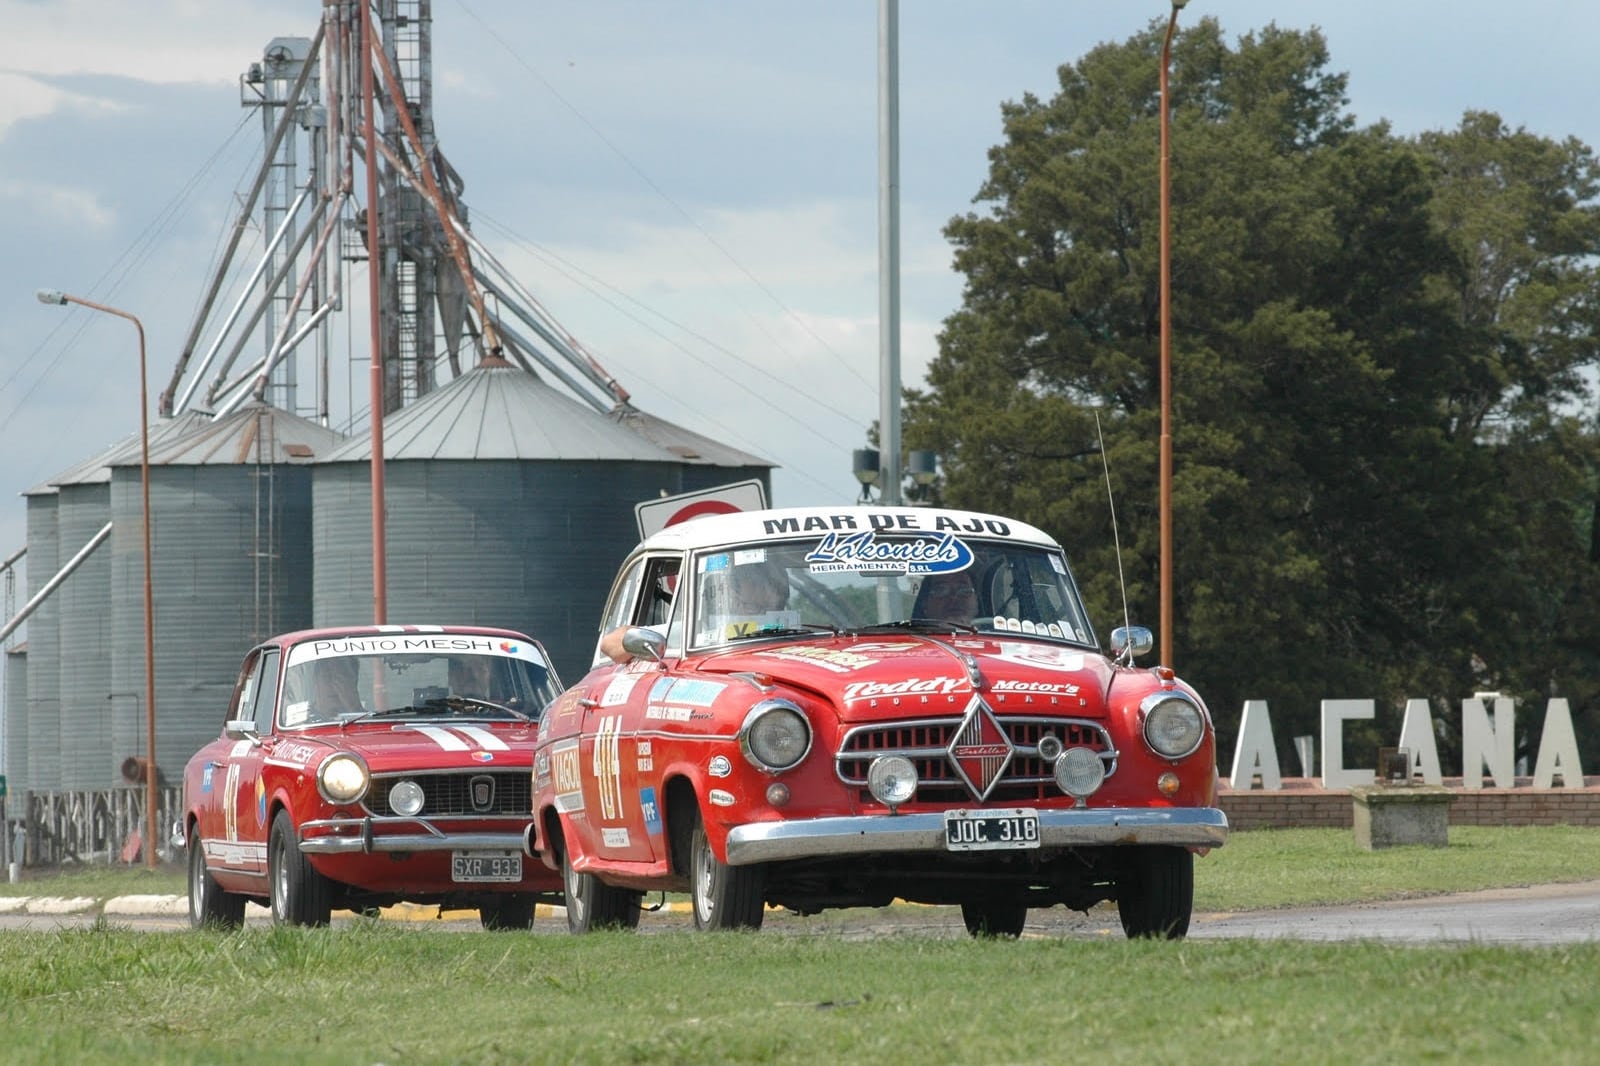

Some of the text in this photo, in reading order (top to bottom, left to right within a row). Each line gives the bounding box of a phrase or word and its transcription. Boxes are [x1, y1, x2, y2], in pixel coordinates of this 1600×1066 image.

[763, 514, 1011, 537] MAR DE AJO
[807, 531, 957, 561] Lakonich
[812, 562, 906, 573] HERRAMIENTAS
[314, 639, 492, 655] PUNTO MESH
[843, 677, 1080, 699] Teddy Motor's
[594, 715, 624, 820] 404
[641, 802, 656, 821] YPF
[951, 818, 1036, 843] JOC 318
[455, 858, 520, 876] SXR 933
